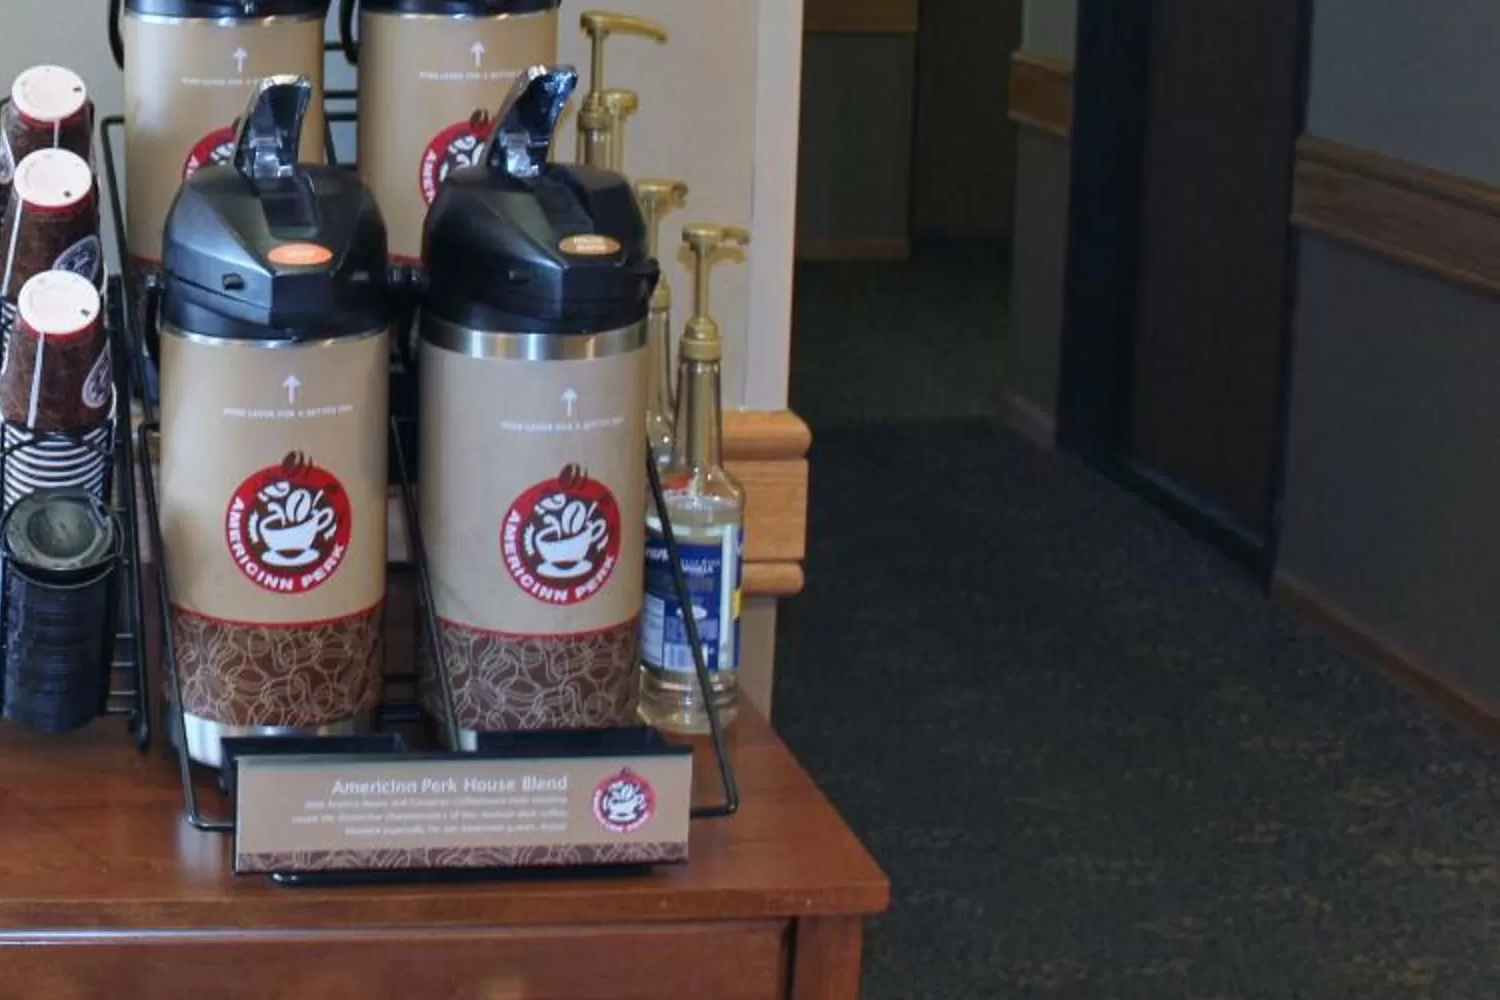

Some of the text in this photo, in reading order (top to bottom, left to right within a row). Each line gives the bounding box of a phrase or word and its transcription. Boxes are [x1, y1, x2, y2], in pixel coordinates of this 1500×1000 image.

[228, 495, 345, 591] AMERICINN PERK
[421, 775, 457, 793] Perk
[462, 776, 517, 792] House
[521, 774, 568, 791] Blend
